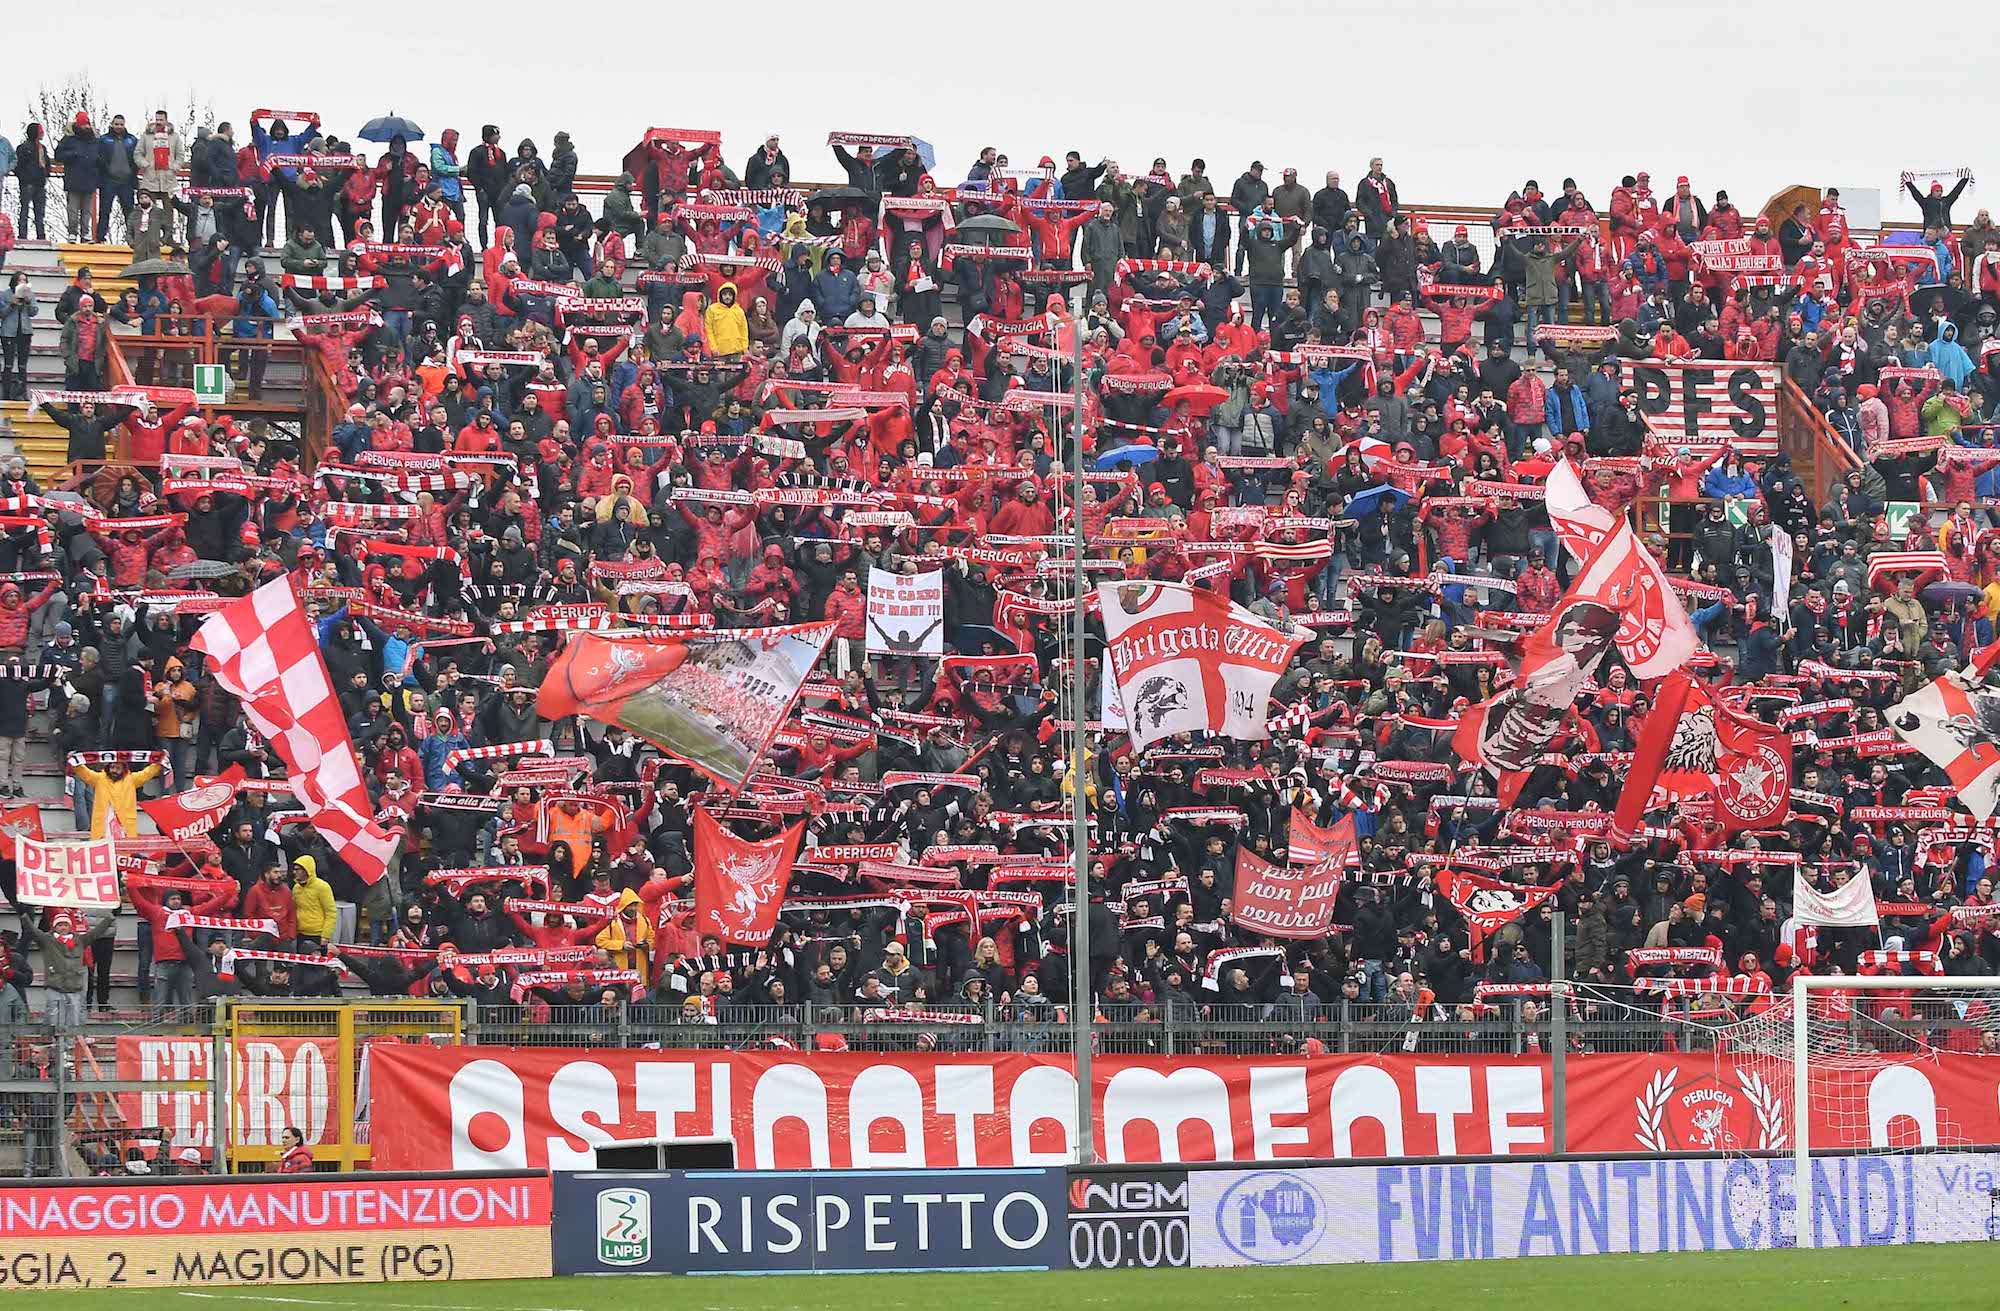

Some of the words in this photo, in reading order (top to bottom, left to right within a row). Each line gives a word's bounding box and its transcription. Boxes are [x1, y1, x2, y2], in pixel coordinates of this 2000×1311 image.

[681, 208, 715, 220] PERUGIA
[988, 246, 1033, 258] MERDA
[1439, 285, 1489, 296] PERUGIA
[322, 313, 367, 323] PERUGIA
[588, 326, 633, 336] PERUGIA
[981, 319, 995, 330] AC
[996, 319, 1045, 335] PERUGIA
[1012, 344, 1047, 360] PERUGIA
[1139, 380, 1173, 391] PERUGIA
[1633, 367, 1766, 438] PFS
[367, 452, 402, 467] PERUGIA
[404, 458, 441, 470] PERUGIA
[912, 468, 969, 481] PERUGIA
[1480, 484, 1513, 498] PERUGIA
[1514, 488, 1547, 501] PERUGIA
[1182, 541, 1246, 551] PERUGIA
[953, 548, 969, 560] AC
[626, 568, 663, 580] PERUGIA
[895, 577, 914, 587] SU
[870, 586, 895, 598] STE
[898, 589, 941, 601] CAZZO
[1686, 588, 1722, 600] PERUGIA
[869, 603, 885, 615] DE
[888, 605, 924, 617] MANI
[1029, 598, 1076, 610] PERUGI
[531, 607, 550, 620] AC
[1315, 611, 1350, 624] MERDA
[1113, 623, 1219, 676] Brigata
[1224, 623, 1291, 665] Ultra
[1784, 703, 1827, 716] Perugia
[1854, 730, 1893, 745] PERUGIA
[1201, 772, 1233, 788] ERUGIA
[1409, 769, 1447, 782] PERUGIA
[457, 796, 479, 807] alla
[1725, 795, 1780, 819] PERUGIA
[172, 814, 214, 841] FORZA
[1526, 816, 1564, 830] PERUGIA
[1565, 818, 1604, 830] PERUGIA
[23, 844, 111, 874] DEMO
[814, 847, 832, 859] AC
[834, 846, 894, 860] PERUGIA
[976, 889, 991, 900] AC
[992, 890, 1041, 905] PERUGIA
[1246, 879, 1292, 901] non
[1239, 904, 1325, 928] venire!
[733, 927, 775, 942] GIULIA
[454, 955, 491, 966] TERNI
[492, 953, 537, 965] MERDA
[1673, 949, 1715, 963] MERDA
[1476, 983, 1519, 994] TERNA
[139, 1041, 329, 1147] FERRO
[1681, 1088, 1735, 1109] PERUGIA
[1084, 1180, 1189, 1210] NGM
[200, 1186, 529, 1228] MANUTENZIONI
[1376, 1166, 1494, 1261] FVM
[1518, 1156, 1915, 1258] ANTINCENDI
[688, 1190, 1050, 1255] RISPETTO
[1069, 1218, 1190, 1269] 00:00
[605, 1244, 643, 1258] LNPB
[0, 1252, 92, 1288] GIA,
[106, 1251, 128, 1282] 2
[173, 1246, 365, 1282] MAGIONE
[380, 1243, 454, 1281] (PG)
